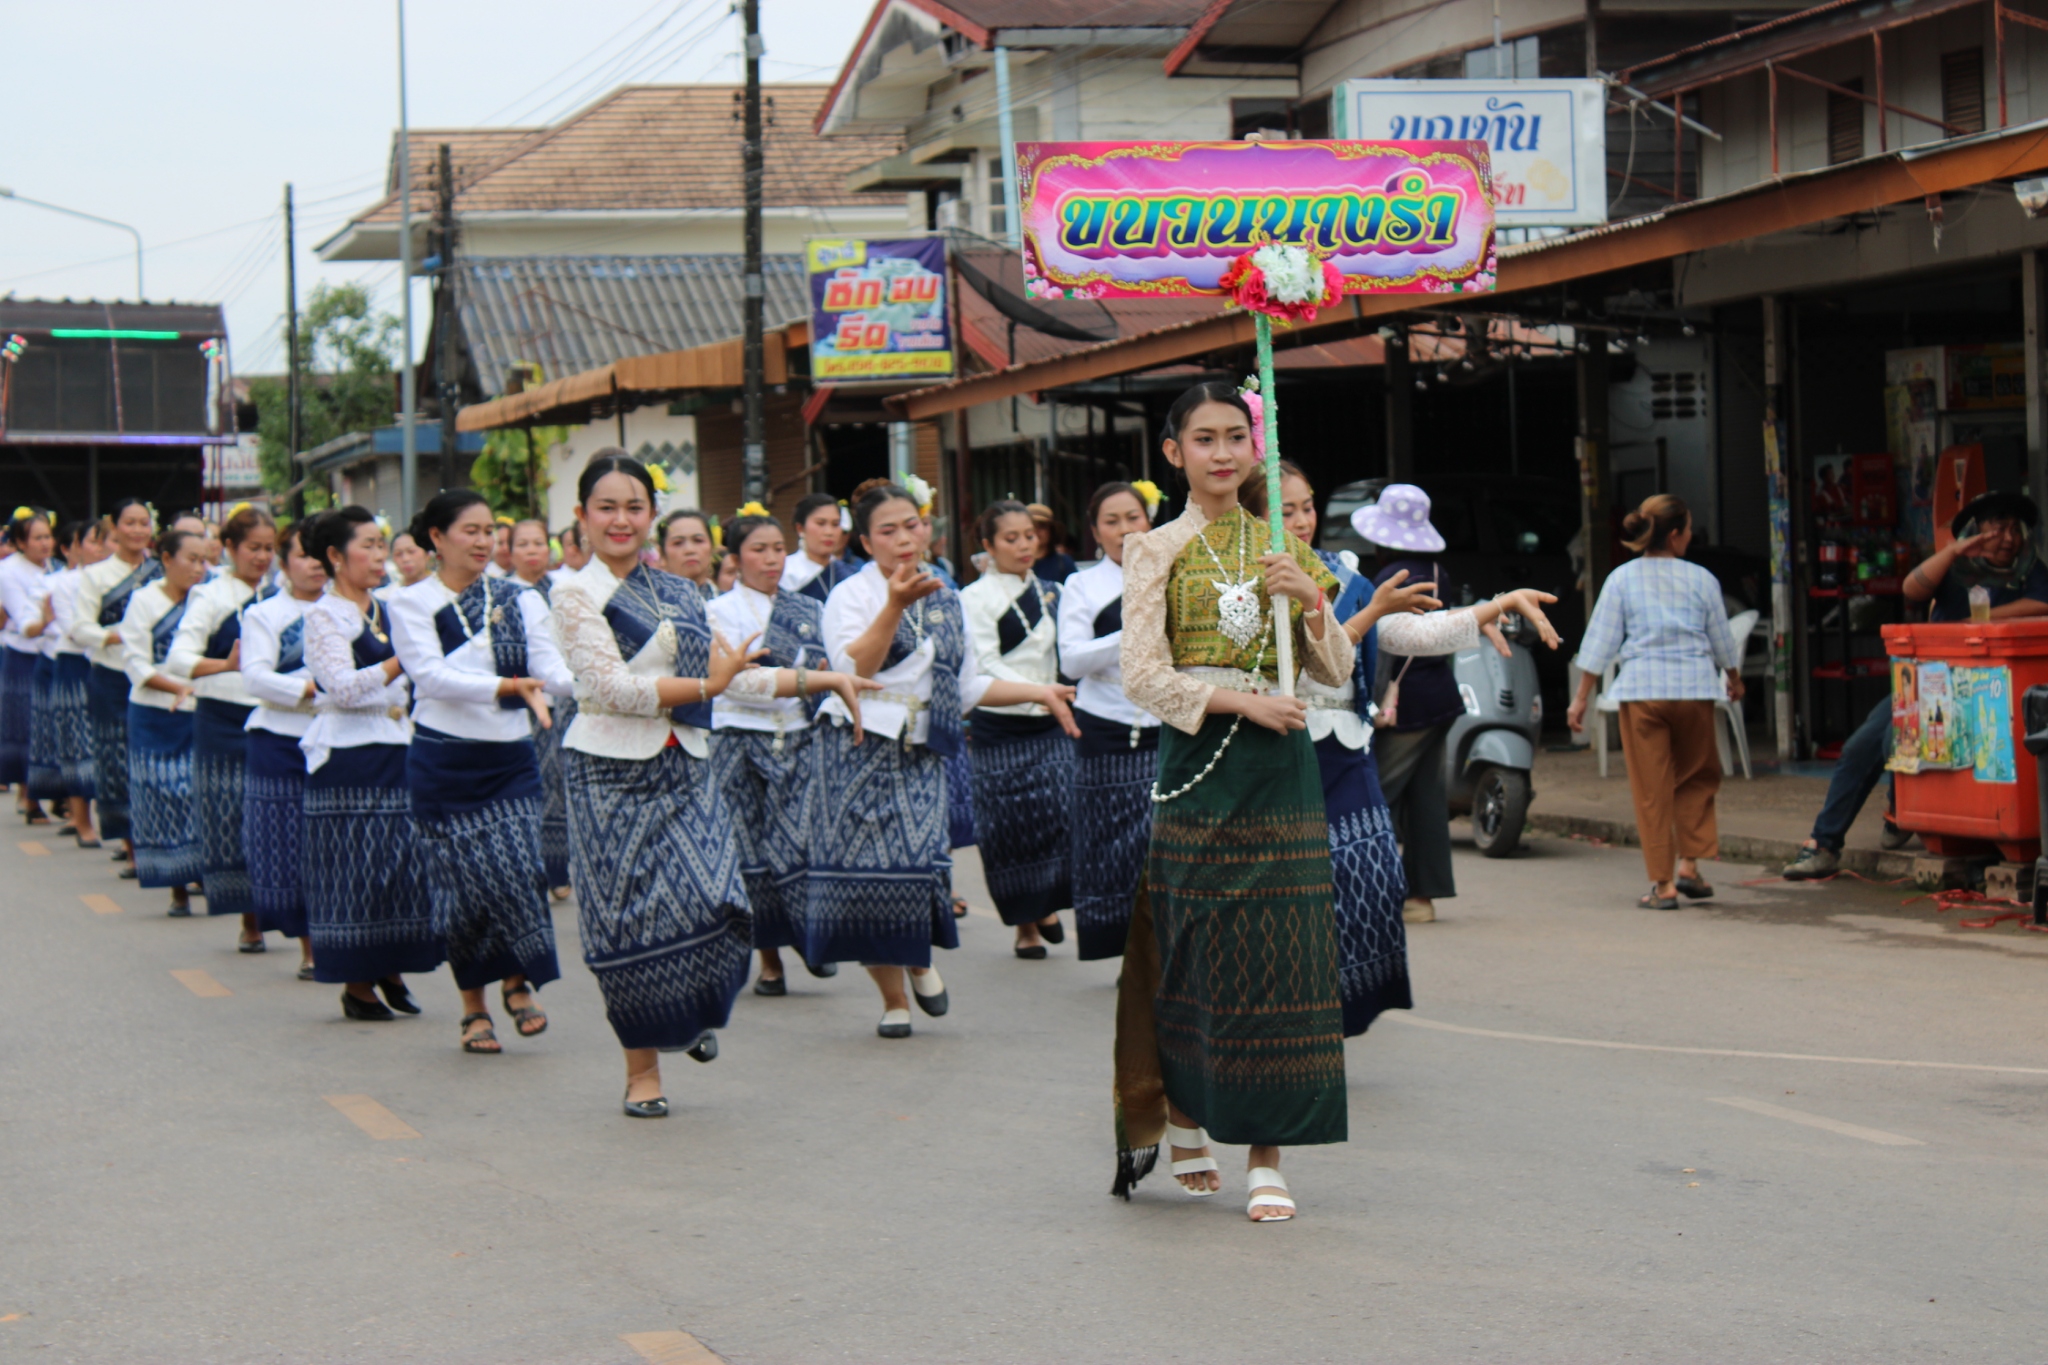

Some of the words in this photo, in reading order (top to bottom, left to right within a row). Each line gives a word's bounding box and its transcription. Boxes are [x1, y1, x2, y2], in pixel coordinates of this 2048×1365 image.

[1061, 176, 1460, 250] ขบวนนางรำ
[892, 276, 939, 301] อบ
[837, 314, 888, 349] รีด
